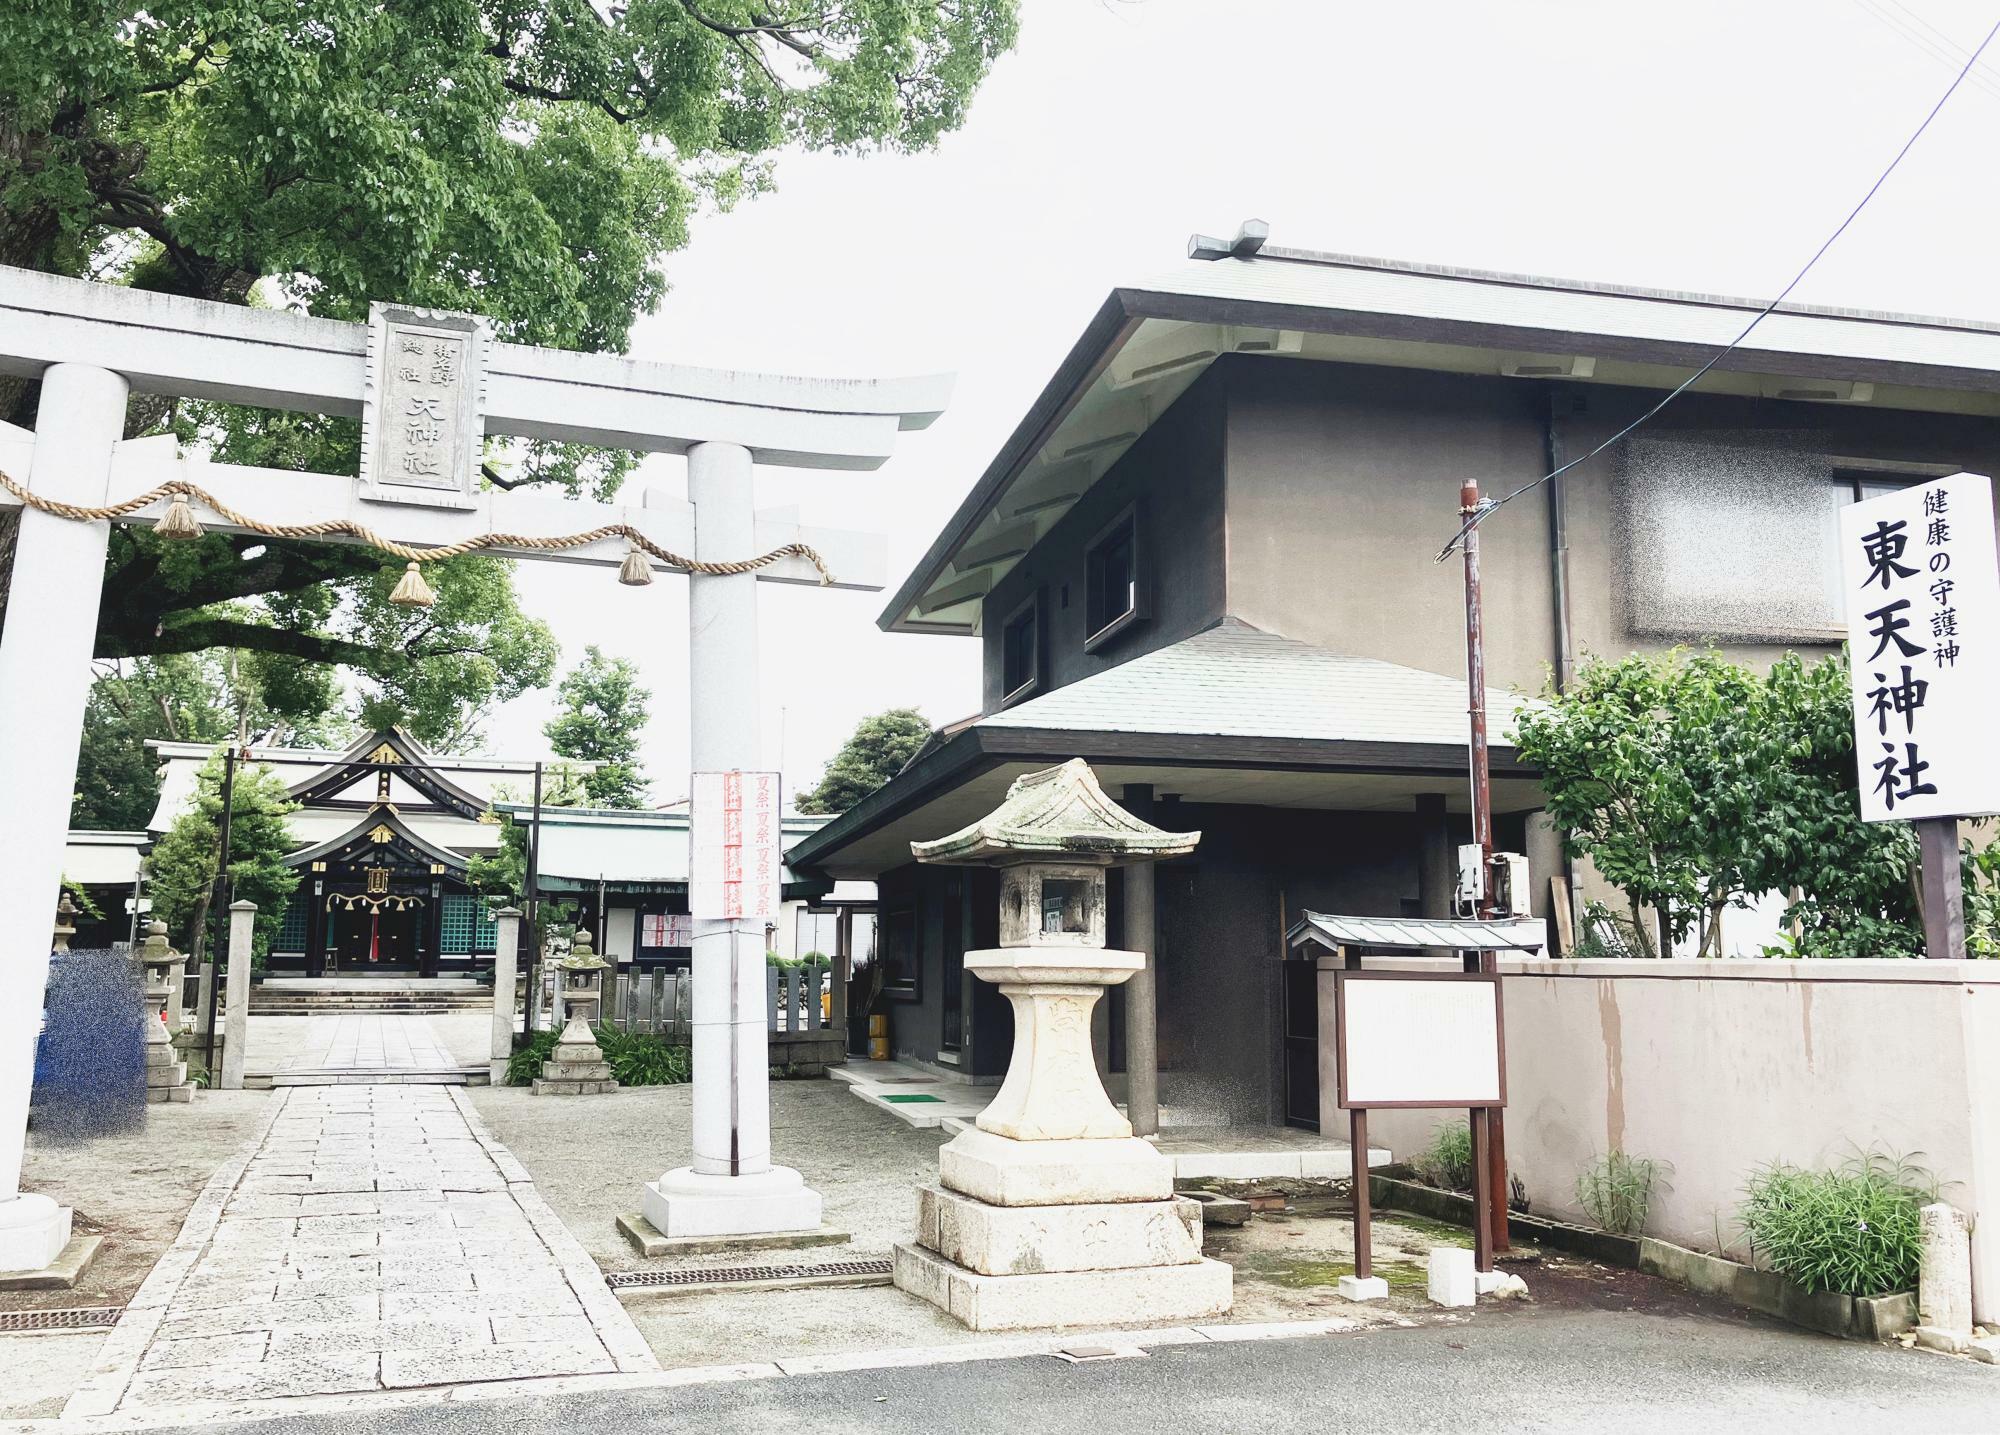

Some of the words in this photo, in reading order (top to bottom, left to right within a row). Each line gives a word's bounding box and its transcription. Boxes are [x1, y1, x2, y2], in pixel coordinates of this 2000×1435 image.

[403, 397, 446, 476] 天神社
[1922, 488, 1961, 669] 健康の守護神
[1860, 519, 1938, 811] 東天神社
[755, 775, 770, 808] 夏祭
[755, 811, 770, 844] 夏祭
[755, 847, 770, 880] 夏祭
[755, 883, 770, 916] 夏祭
